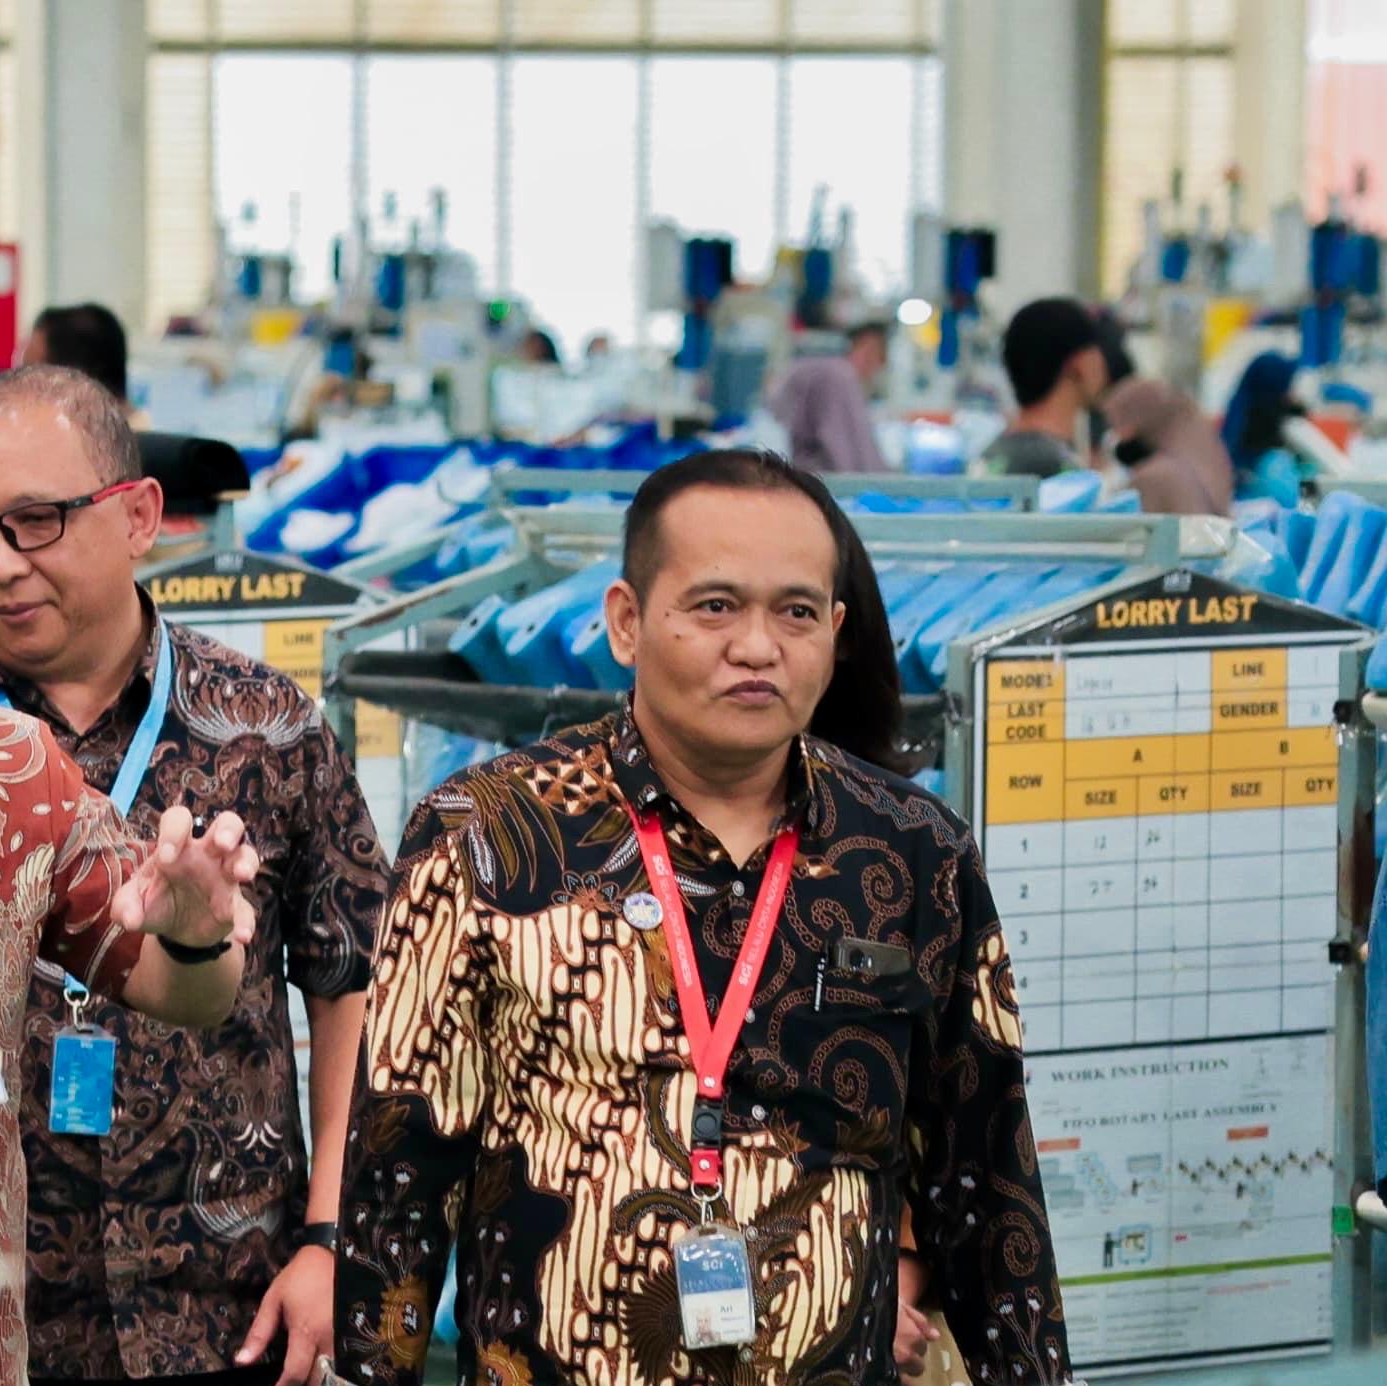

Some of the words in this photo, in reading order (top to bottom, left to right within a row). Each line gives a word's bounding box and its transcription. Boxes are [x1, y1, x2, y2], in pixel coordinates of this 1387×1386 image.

[150, 576, 236, 604] LORRY
[241, 573, 306, 600] LAST
[1095, 598, 1182, 629] LORRY
[1188, 594, 1259, 624] LAST
[1232, 662, 1264, 677] LINE
[1007, 703, 1045, 719] LAST
[1220, 702, 1279, 718] GENDER
[1006, 725, 1046, 740] CODE
[1132, 748, 1143, 763] A
[1279, 741, 1290, 755] B
[1009, 775, 1043, 790] ROW
[1231, 782, 1263, 798] SIZE
[1305, 778, 1335, 793] QTY
[1085, 790, 1117, 806] SIZE
[1159, 786, 1188, 802] QTY
[1051, 1068, 1106, 1083] WORK
[1111, 1058, 1229, 1080] INSTRUCTION
